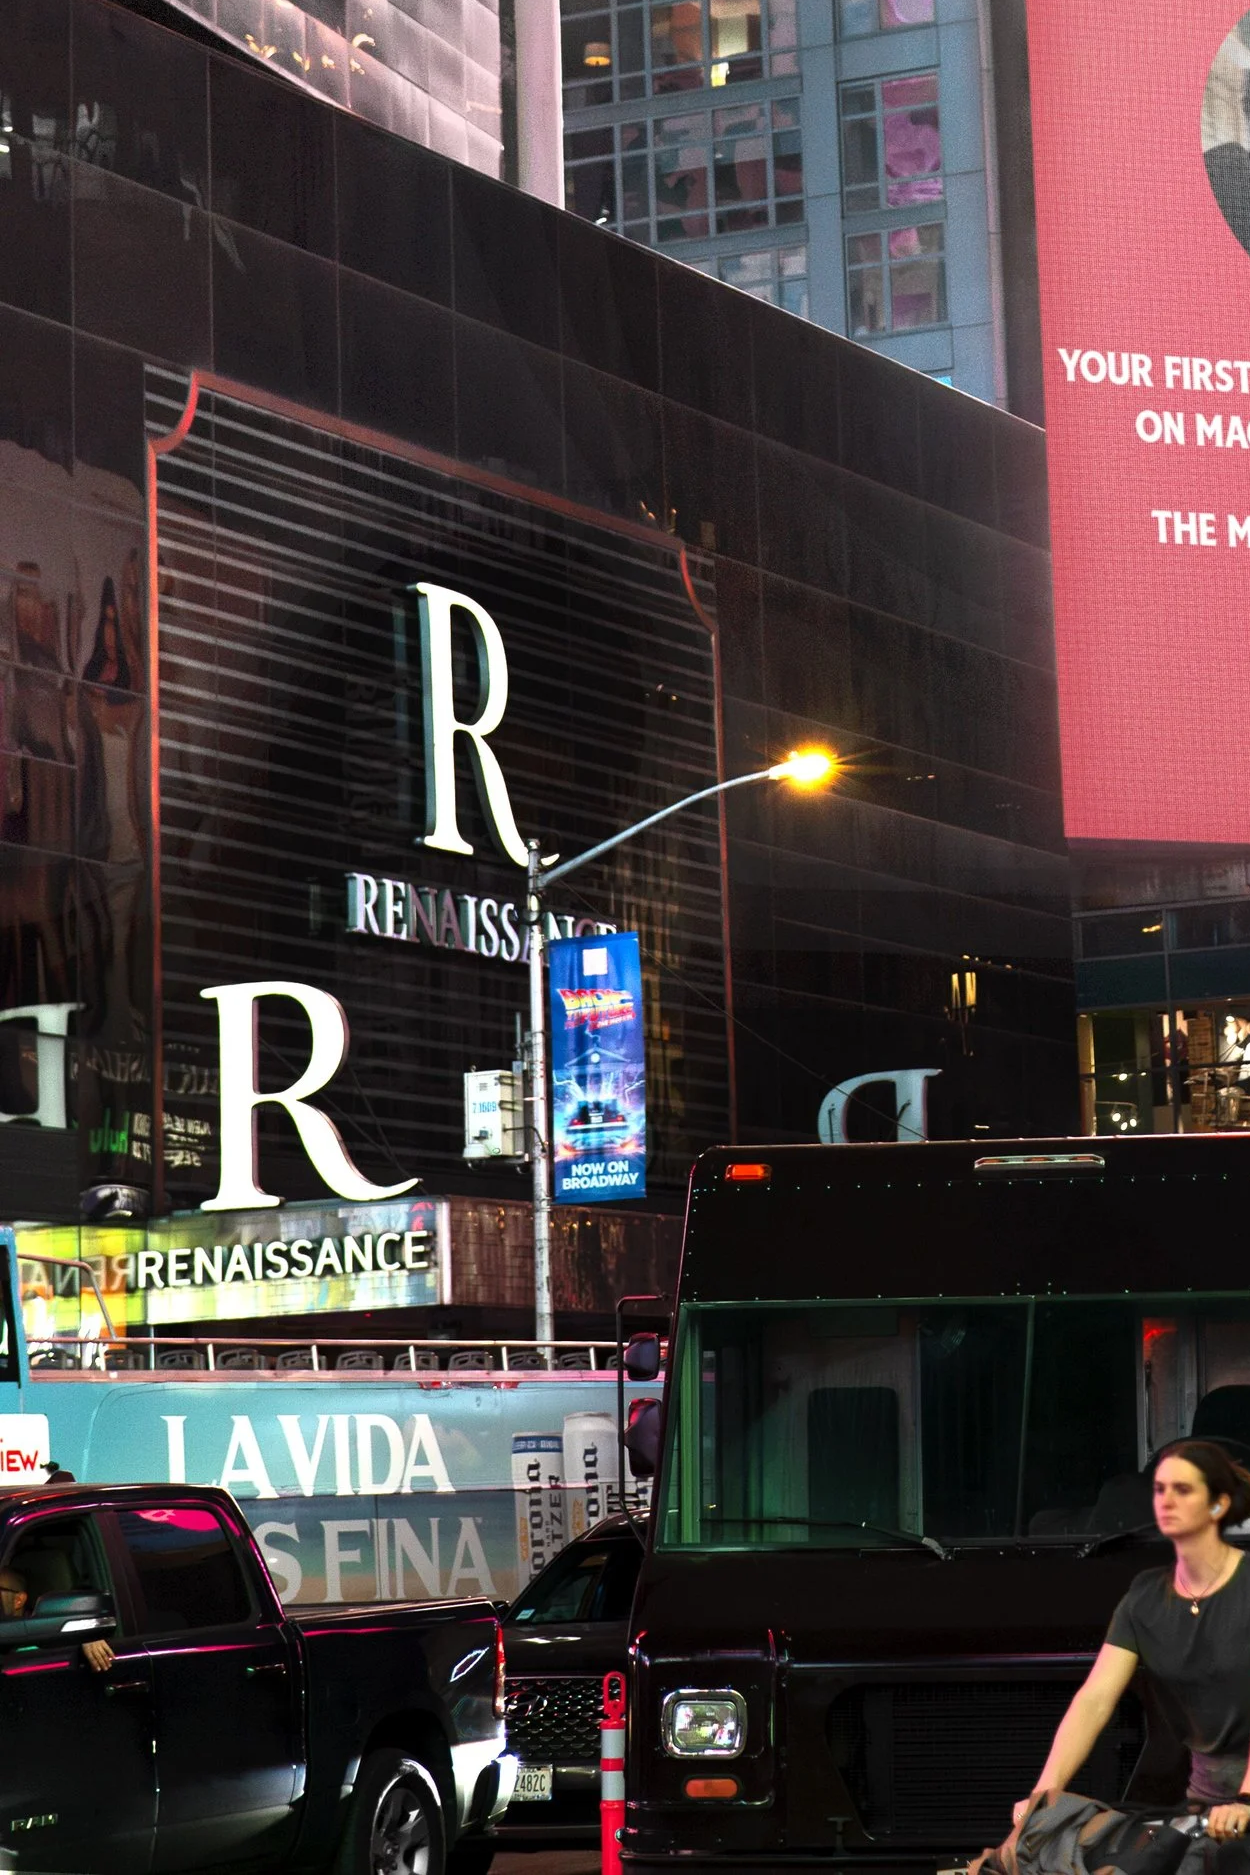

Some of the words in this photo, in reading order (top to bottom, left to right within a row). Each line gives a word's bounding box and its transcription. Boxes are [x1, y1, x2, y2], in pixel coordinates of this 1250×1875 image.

[1057, 348, 1153, 387] YOUR
[1135, 409, 1185, 445] ON
[1151, 510, 1217, 547] THE
[406, 582, 560, 867] R
[200, 981, 425, 1211] R
[562, 1172, 639, 1190] BROADWAY
[571, 1162, 605, 1176] NOW
[607, 1160, 629, 1173] ON
[138, 1230, 429, 1290] RENAISSANCE
[160, 1415, 280, 1499] LA
[277, 1414, 456, 1497] VIDA
[323, 1516, 498, 1604] FINA
[514, 1774, 546, 1793] 2482C
